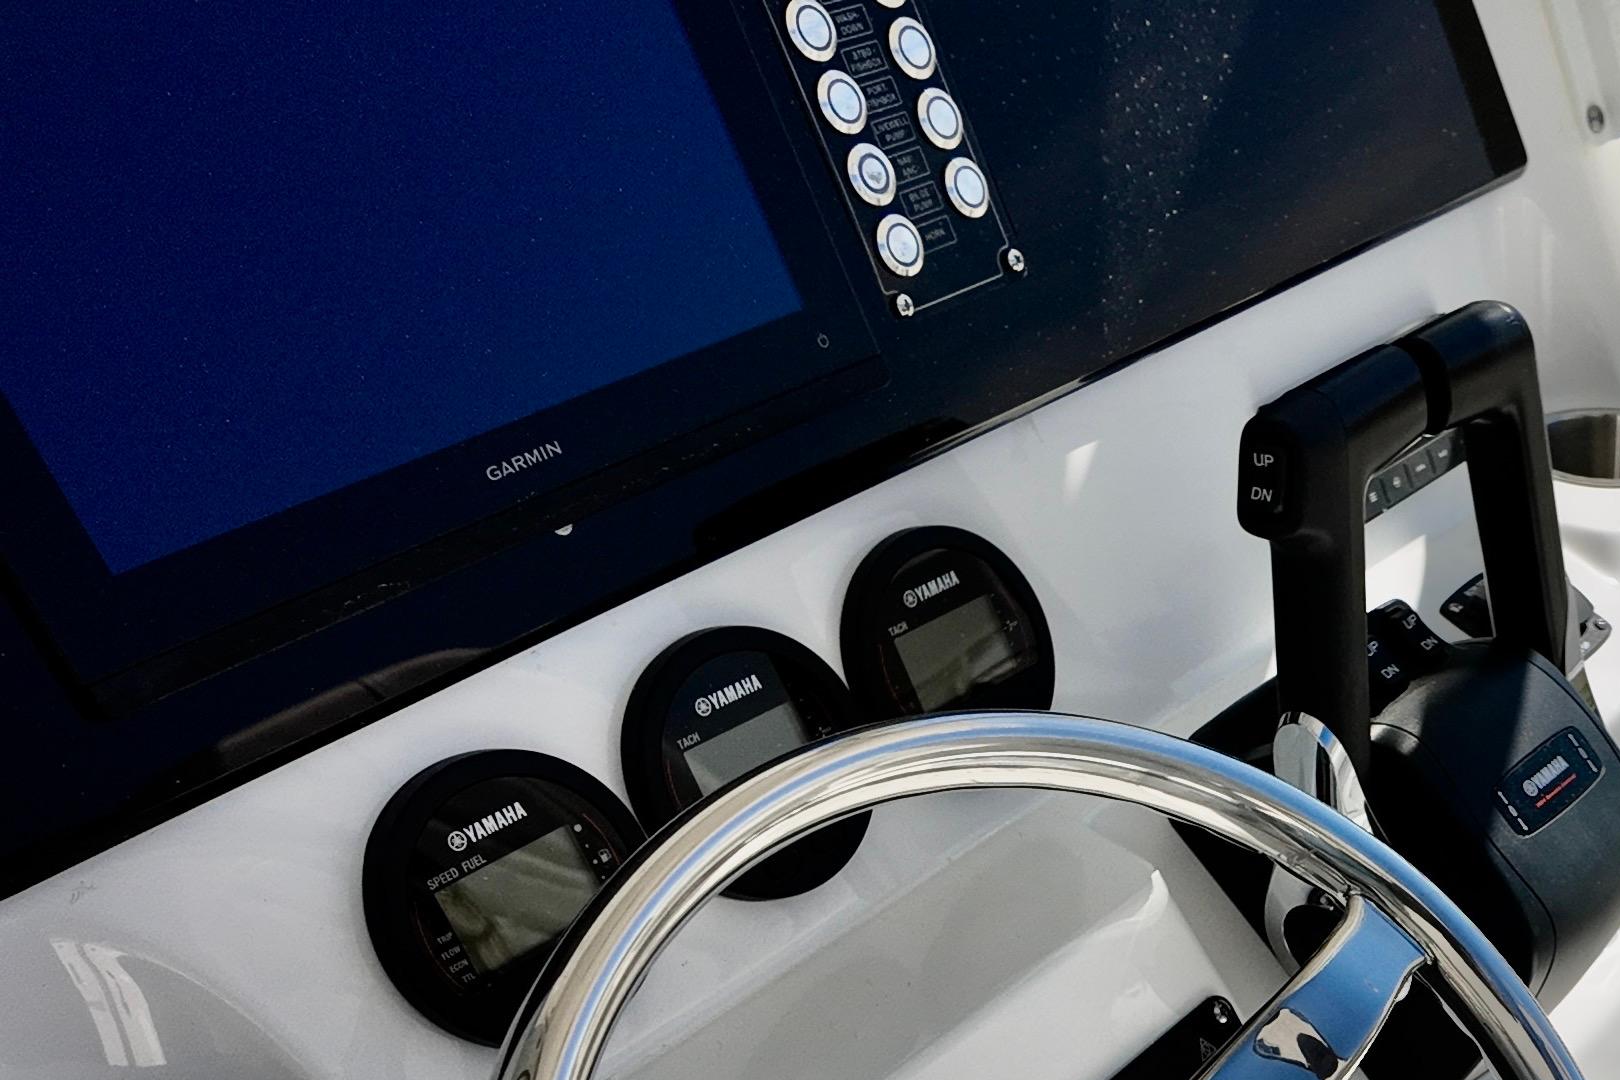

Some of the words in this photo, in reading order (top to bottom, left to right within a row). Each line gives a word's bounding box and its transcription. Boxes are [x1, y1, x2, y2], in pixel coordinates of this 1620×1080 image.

[486, 441, 562, 481] GARMIN
[1253, 453, 1274, 467] UP
[1250, 487, 1273, 502] DN
[914, 570, 960, 602] YAMAHA
[1402, 613, 1417, 630] UP
[1421, 636, 1439, 651] DN
[1381, 664, 1400, 679] DN
[708, 674, 763, 710] YAMAHA
[676, 732, 701, 750] TACH
[1530, 755, 1570, 790] YAMAHA
[463, 801, 528, 843] YAMAHA
[426, 866, 459, 891] SPEED
[461, 854, 487, 873] FUEL
[441, 945, 461, 960] FLOW
[449, 958, 469, 973] ECON
